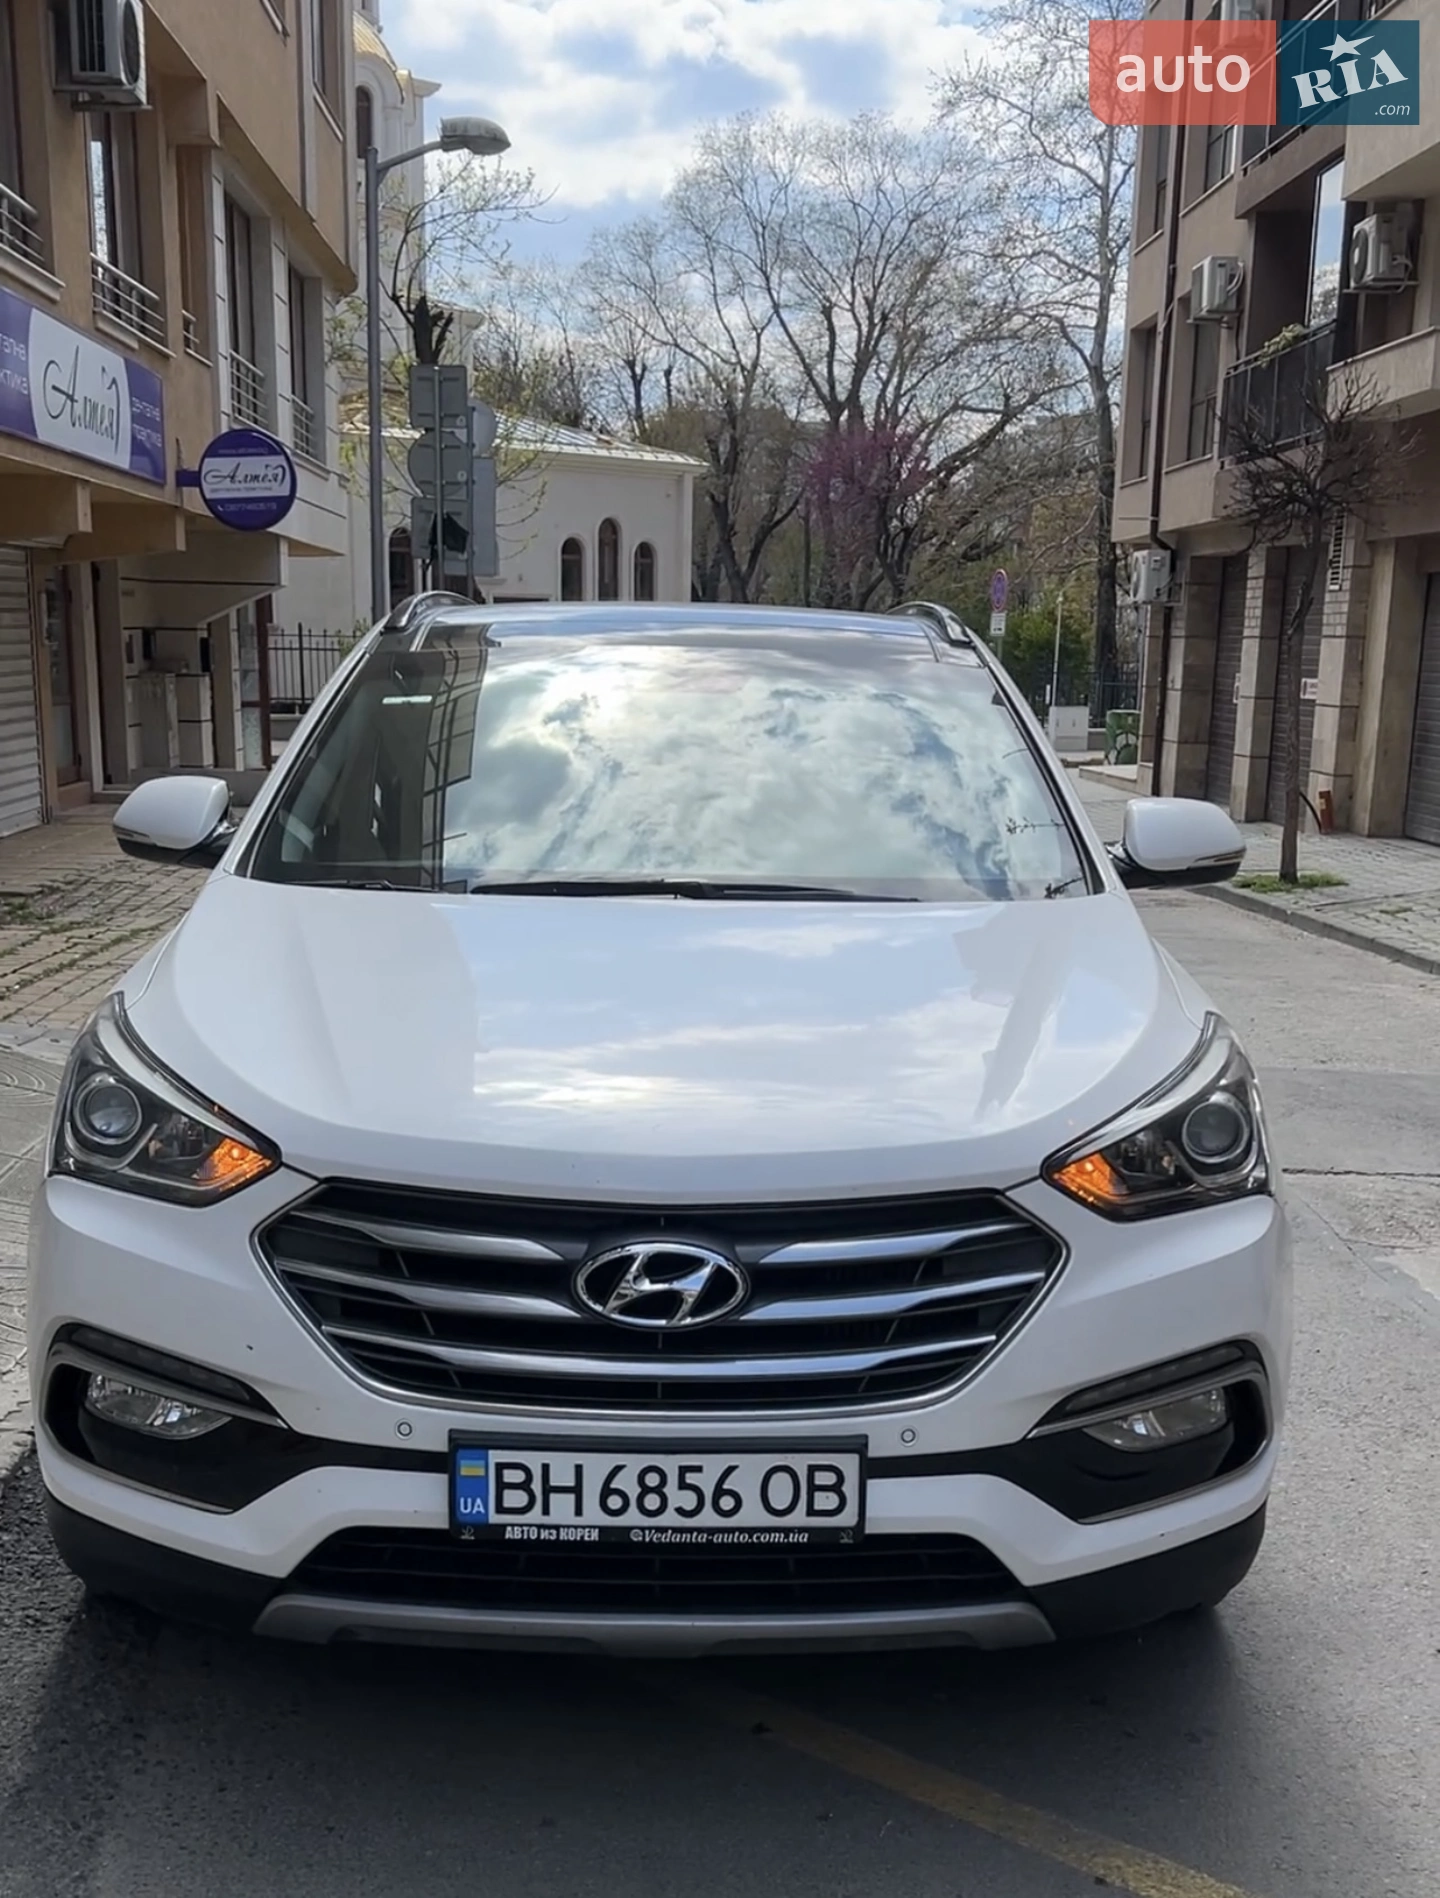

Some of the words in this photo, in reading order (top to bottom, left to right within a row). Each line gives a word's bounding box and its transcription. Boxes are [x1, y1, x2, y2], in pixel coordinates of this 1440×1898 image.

[494, 1462, 583, 1517] BH
[599, 1464, 743, 1518] 6856
[760, 1463, 847, 1518] OB
[459, 1497, 485, 1514] UA
[505, 1526, 538, 1540] АВТО
[540, 1528, 557, 1540] из
